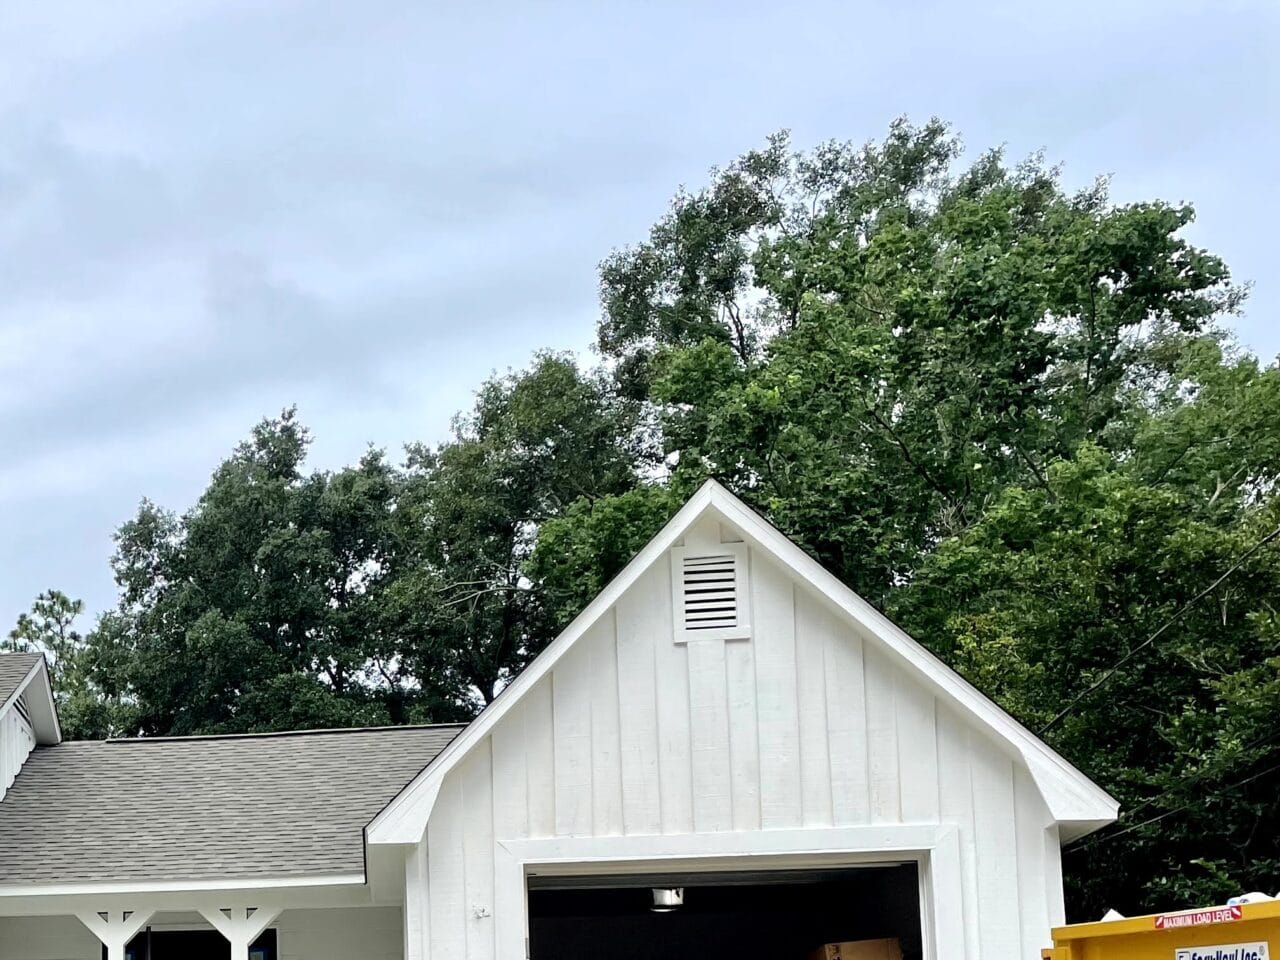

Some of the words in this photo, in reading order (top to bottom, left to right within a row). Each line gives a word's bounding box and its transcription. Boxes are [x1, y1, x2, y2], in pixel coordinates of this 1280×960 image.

[1163, 915, 1192, 928] MAXIMUM
[1193, 912, 1212, 925] LOAD
[1212, 910, 1233, 923] LEVEL
